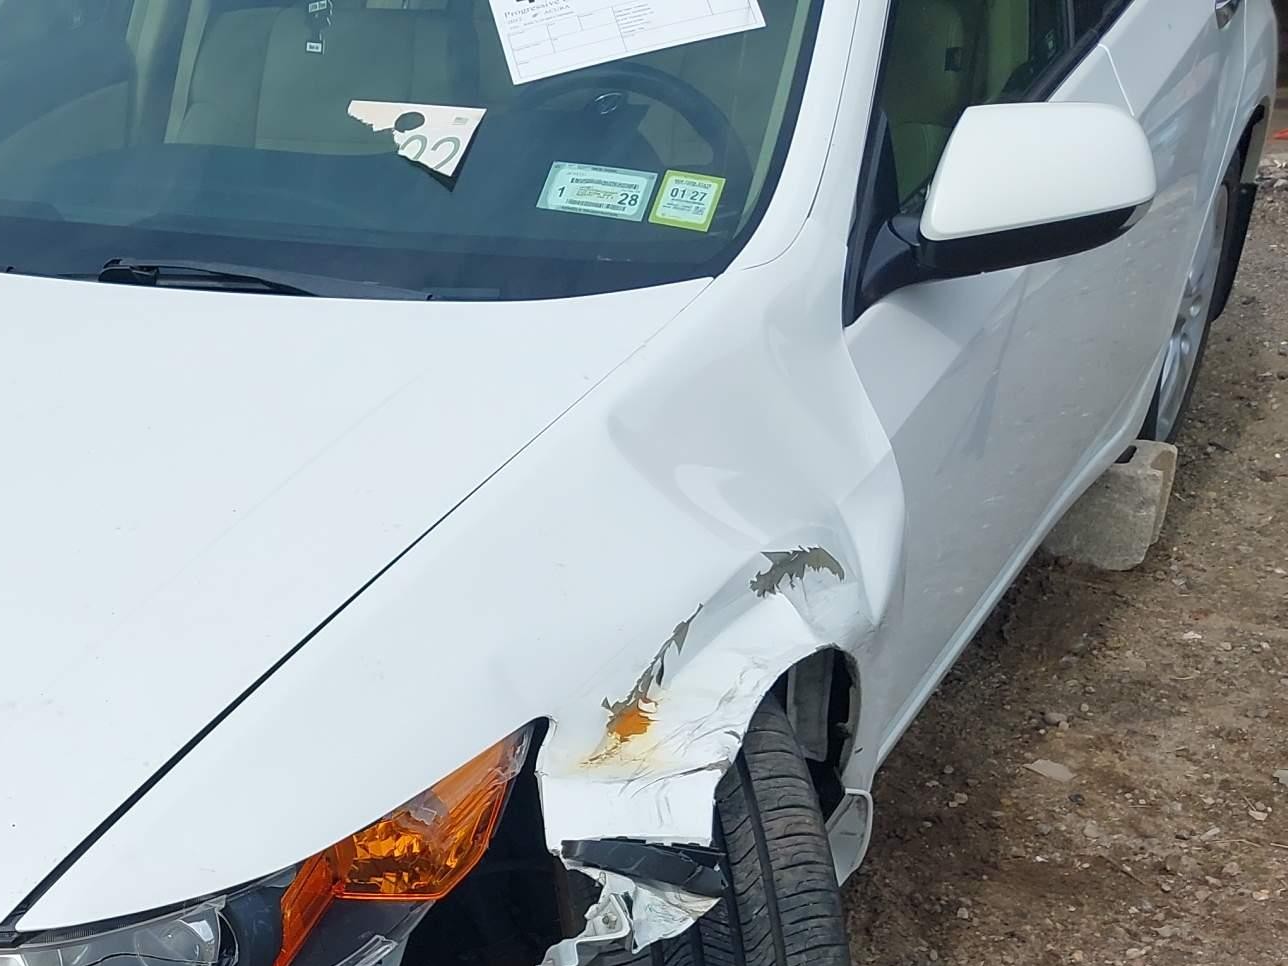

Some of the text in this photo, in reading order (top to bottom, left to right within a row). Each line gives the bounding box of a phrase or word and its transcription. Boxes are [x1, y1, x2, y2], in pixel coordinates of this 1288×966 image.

[557, 186, 566, 198] 1
[617, 192, 639, 206] 28
[670, 187, 708, 202] 01 27
